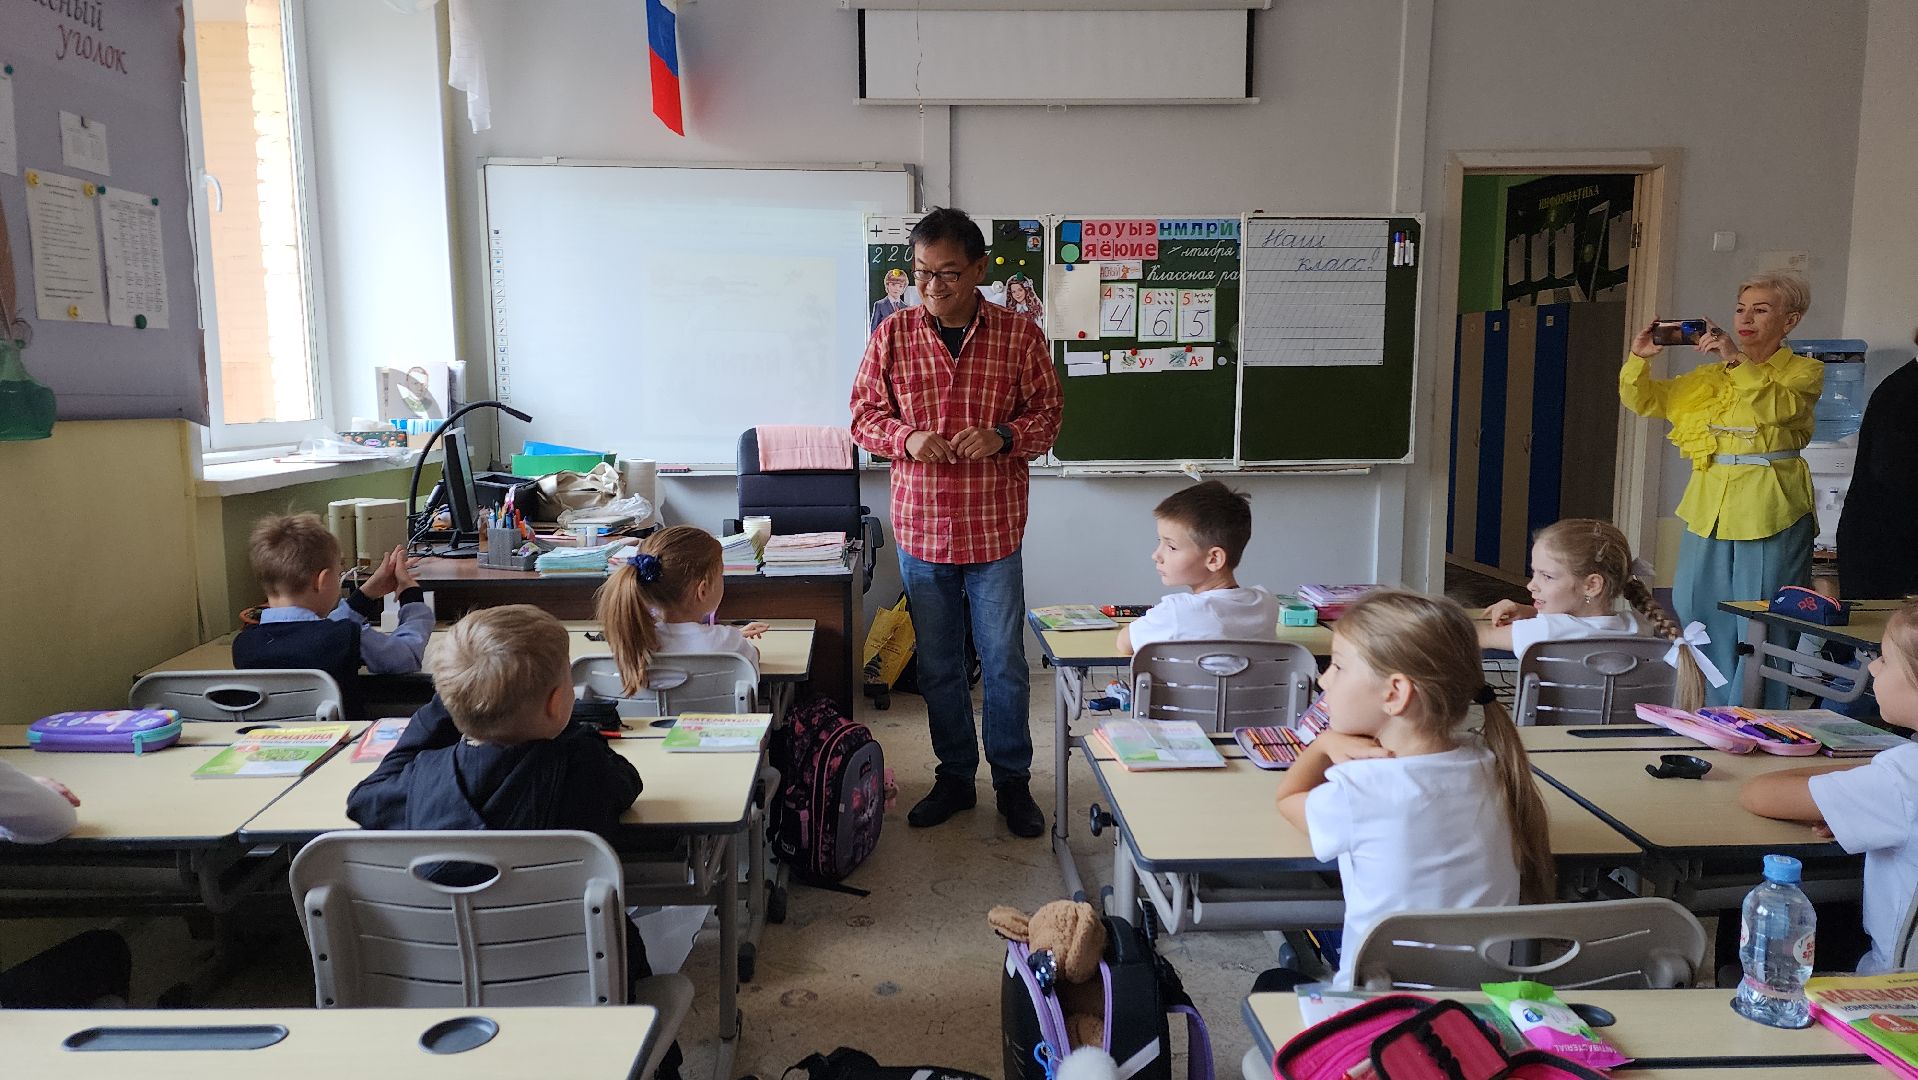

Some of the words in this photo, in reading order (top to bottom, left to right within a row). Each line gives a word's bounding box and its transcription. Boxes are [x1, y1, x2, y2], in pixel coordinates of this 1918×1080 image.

[56, 24, 127, 75] уголок
[1262, 228, 1326, 248] Наш
[1147, 264, 1217, 281] Классная
[1216, 270, 1240, 287] ра
[1104, 288, 1113, 299] 4
[1144, 292, 1153, 304] 6
[1183, 292, 1191, 305] 5
[1109, 304, 1131, 331] 4
[1153, 309, 1171, 336] 6
[1189, 309, 1210, 337] 5
[1138, 357, 1154, 369] Уу
